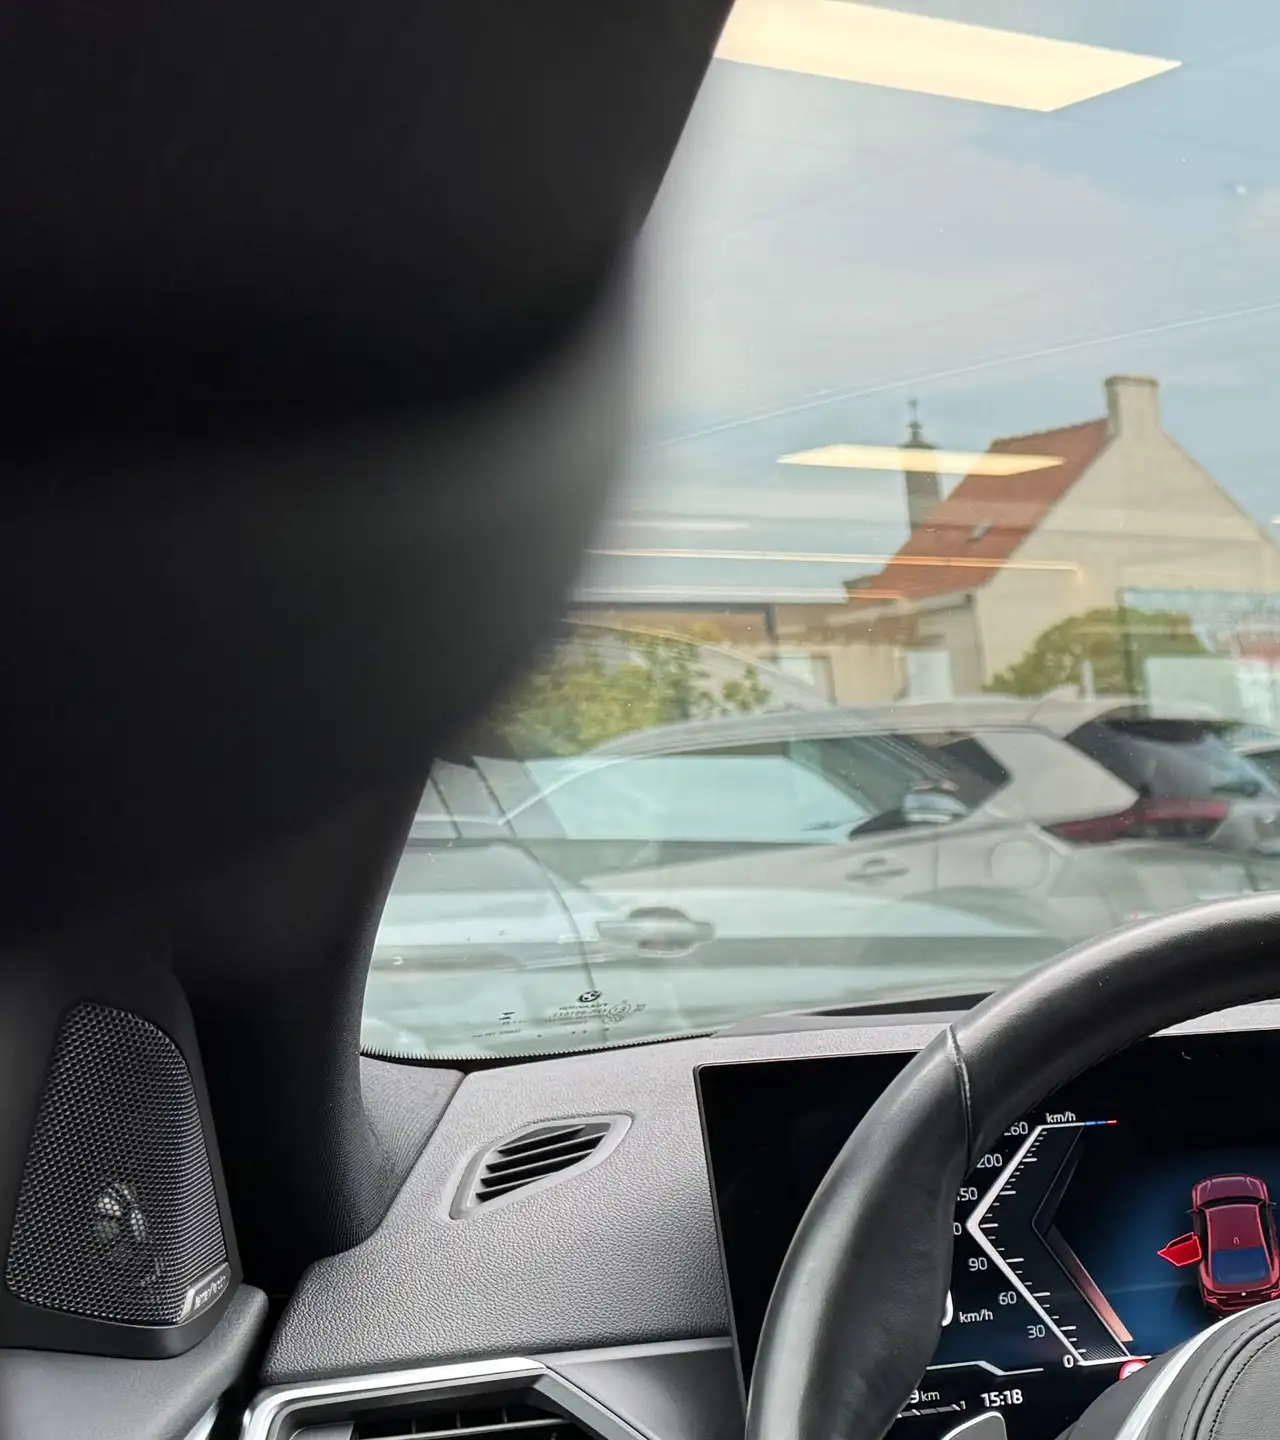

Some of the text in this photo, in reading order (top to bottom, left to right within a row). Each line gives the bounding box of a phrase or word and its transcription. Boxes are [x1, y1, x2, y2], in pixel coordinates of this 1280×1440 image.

[1045, 1111, 1077, 1123] km/h
[1003, 1121, 1029, 1136] 60
[968, 1257, 988, 1272] 90
[998, 1291, 1017, 1305] 60
[959, 1309, 994, 1324] km/h
[1027, 1324, 1046, 1339] 30
[1063, 1355, 1074, 1368] 0
[980, 1389, 1024, 1408] 15:18
